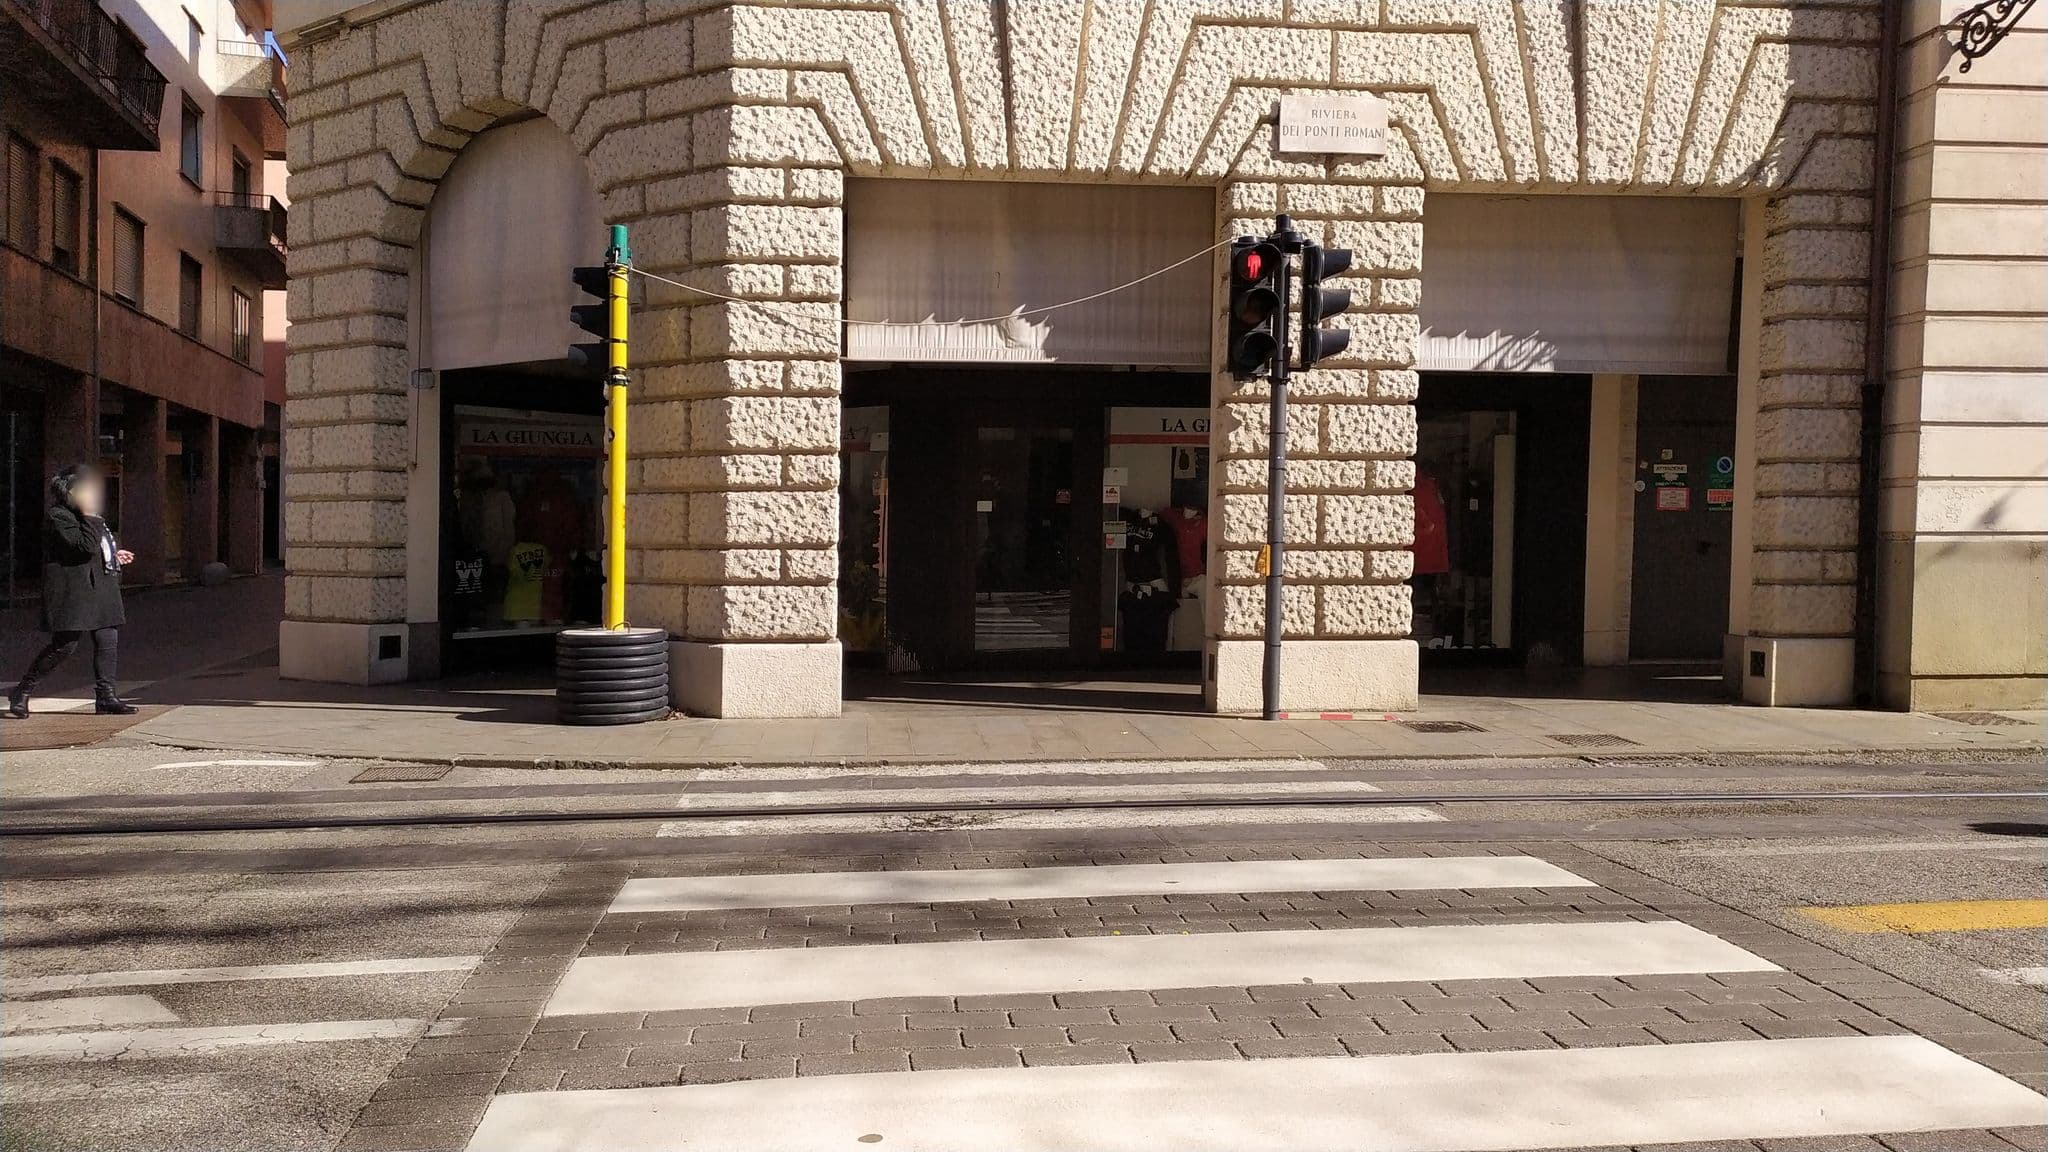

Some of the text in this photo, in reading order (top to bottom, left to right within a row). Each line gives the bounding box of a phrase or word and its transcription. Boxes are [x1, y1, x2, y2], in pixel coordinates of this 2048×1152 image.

[1311, 109, 1358, 120] RIVIERA
[1282, 125, 1386, 139] DEI PONTI ROMANI
[1161, 417, 1188, 433] LA
[471, 429, 594, 446] LA GIUNGLA
